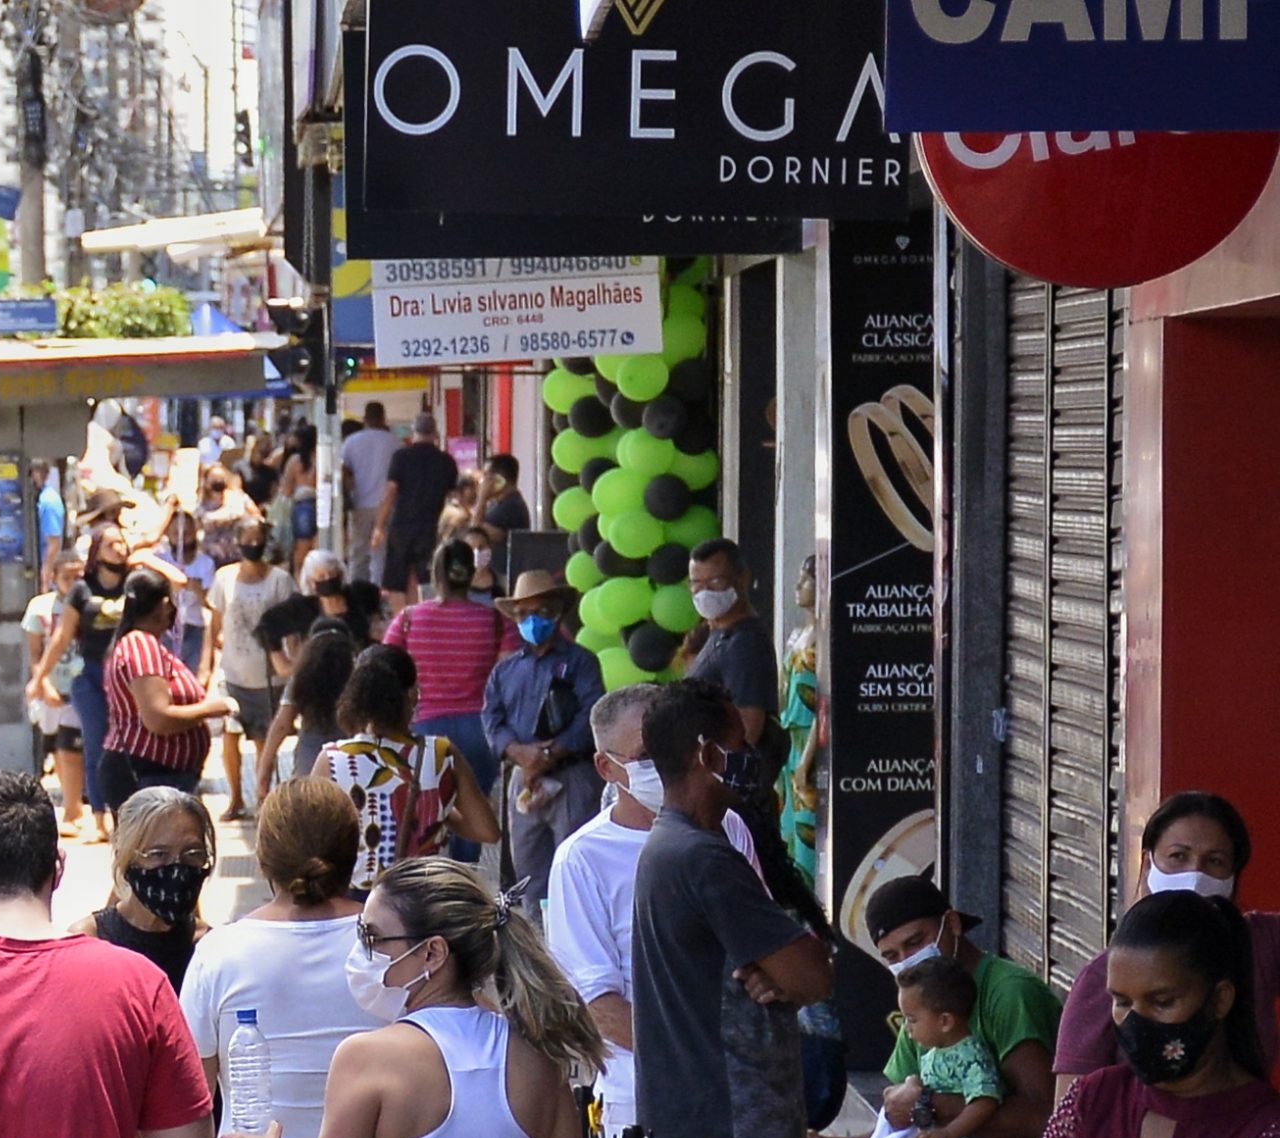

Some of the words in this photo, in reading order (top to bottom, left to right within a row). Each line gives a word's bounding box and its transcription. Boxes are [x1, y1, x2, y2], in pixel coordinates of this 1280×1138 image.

[374, 44, 901, 142] OMEGA
[720, 155, 901, 186] DORNIER
[389, 295, 425, 317] Dra:
[401, 335, 490, 358] 3292-1236
[520, 329, 618, 351] 98580-6577
[859, 682, 892, 697] SEM
[839, 777, 882, 792] COM
[887, 777, 934, 792] DIAM
